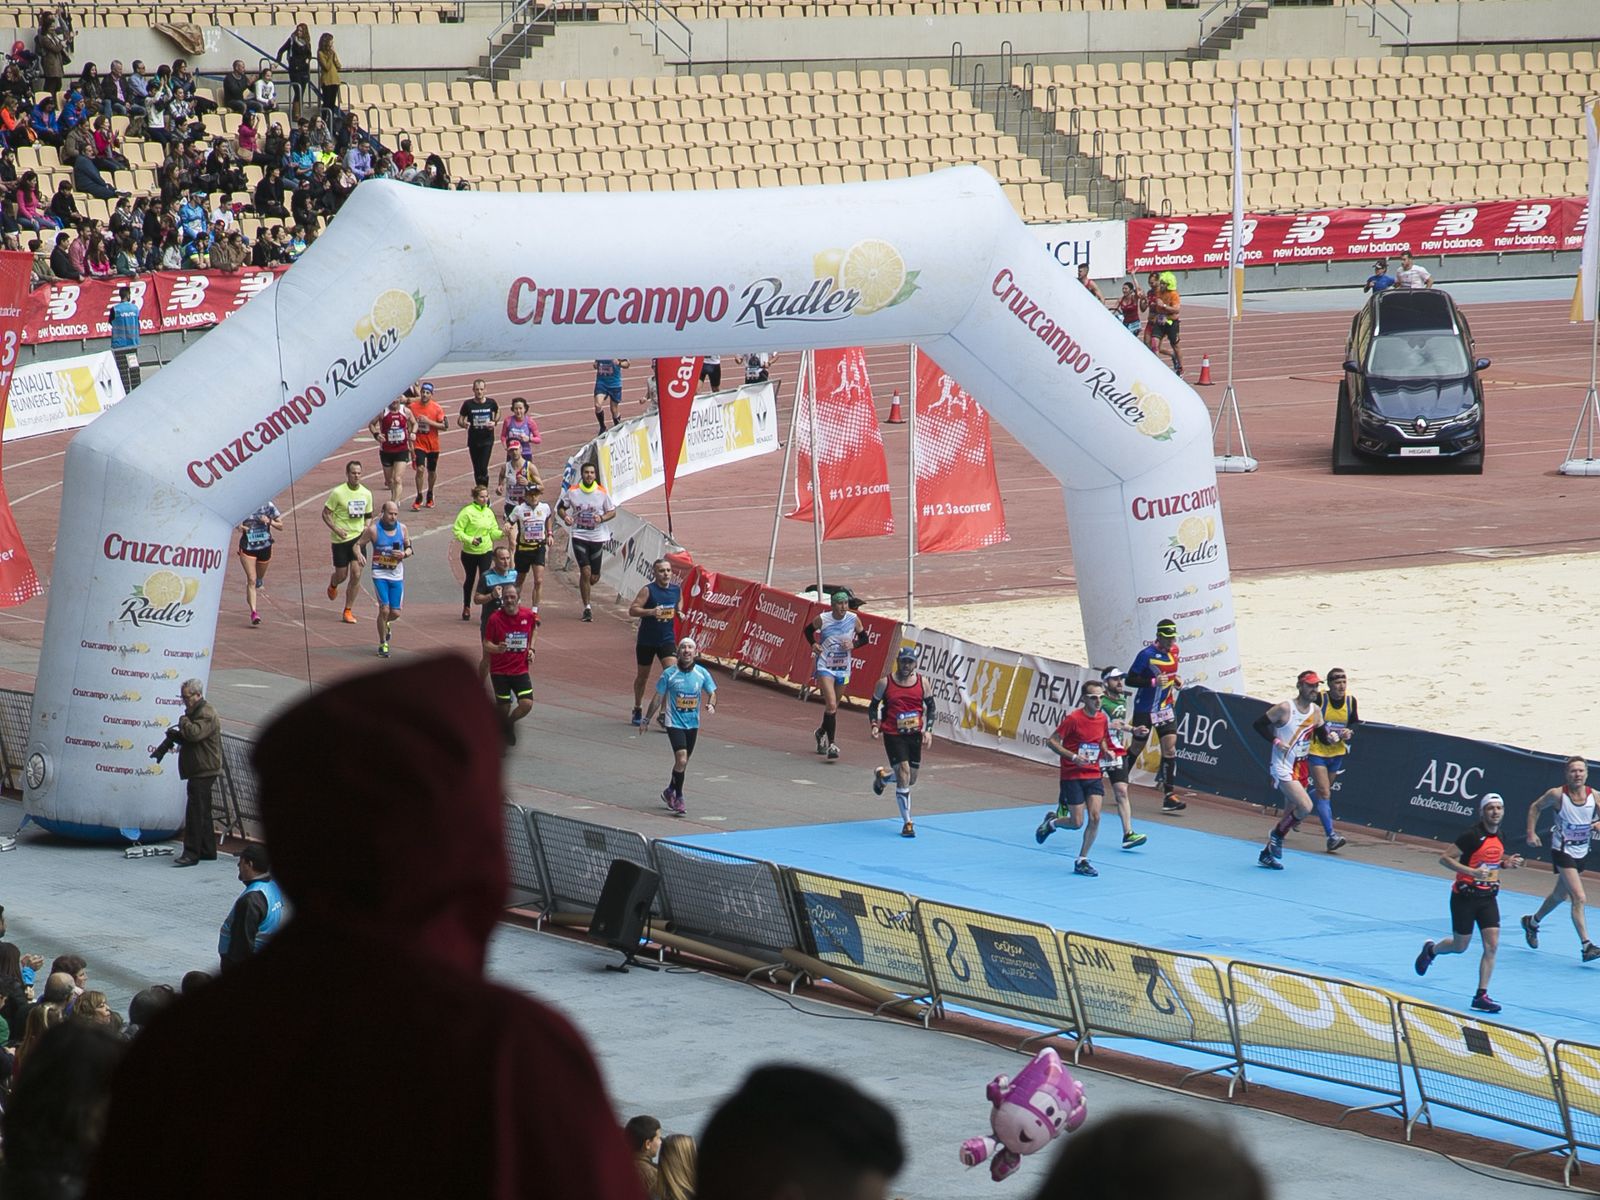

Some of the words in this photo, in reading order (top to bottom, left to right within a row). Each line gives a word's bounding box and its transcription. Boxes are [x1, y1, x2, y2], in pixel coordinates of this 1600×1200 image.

[1204, 252, 1223, 262] new
[1273, 248, 1292, 258] new
[1348, 245, 1368, 254] new
[1421, 240, 1441, 250] new
[1495, 237, 1513, 246] new
[1134, 257, 1153, 267] new
[507, 276, 730, 332] Cruzcampo
[731, 276, 864, 330] Radler
[992, 268, 1092, 374] Cruzcampo
[1082, 366, 1146, 427] Radler
[187, 385, 327, 488] Cruzcampo
[326, 327, 400, 399] Radler
[1131, 485, 1218, 521] Cruzcamp
[104, 532, 222, 574] Cruzcampo
[117, 597, 194, 628] Radler
[755, 592, 799, 625] Santander
[1176, 713, 1227, 750] ABC
[1415, 759, 1485, 800] ABC
[1410, 794, 1474, 817] abcdesevilla.es
